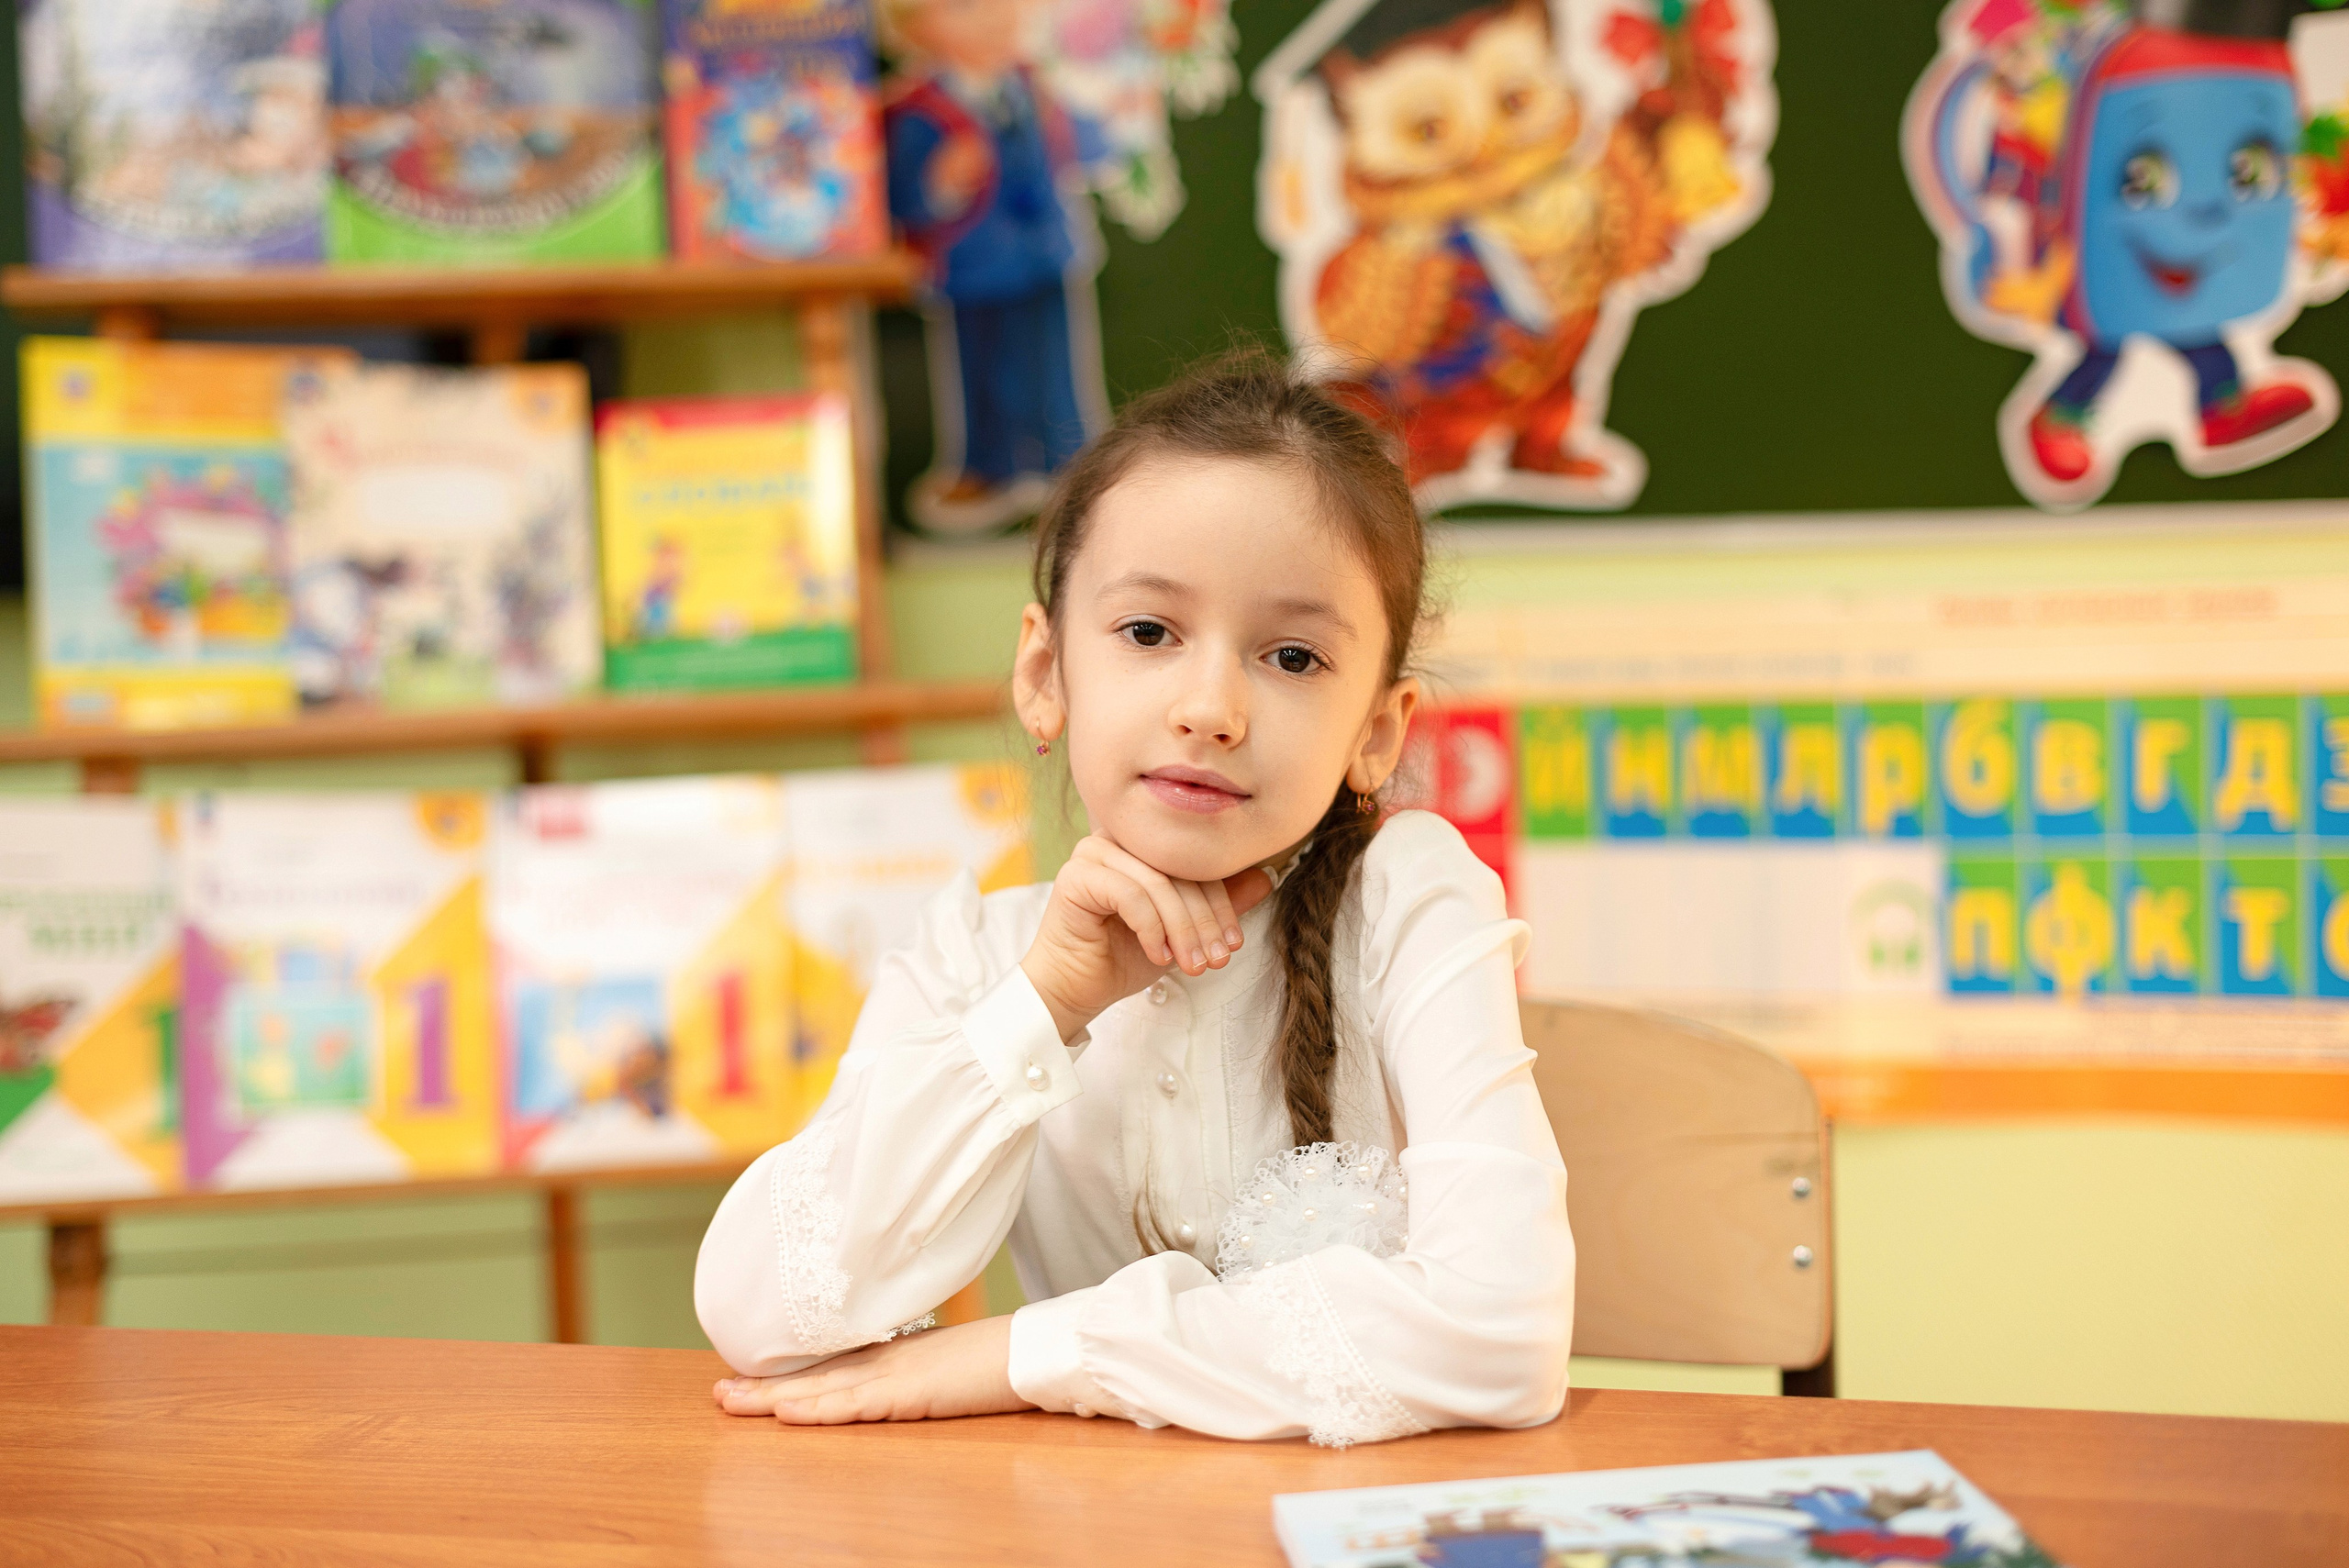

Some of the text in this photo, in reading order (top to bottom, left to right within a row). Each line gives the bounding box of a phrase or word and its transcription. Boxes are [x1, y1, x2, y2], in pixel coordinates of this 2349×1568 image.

[1856, 722, 1924, 839] р
[1942, 695, 2015, 817] б
[2032, 719, 2106, 815] в
[2132, 717, 2193, 813] г
[2214, 717, 2299, 833] д
[1947, 886, 2014, 981] п
[2023, 859, 2115, 1006] ф
[2127, 884, 2197, 981] к
[2223, 886, 2290, 982] т
[404, 978, 459, 1116] 1
[708, 967, 763, 1103] 1
